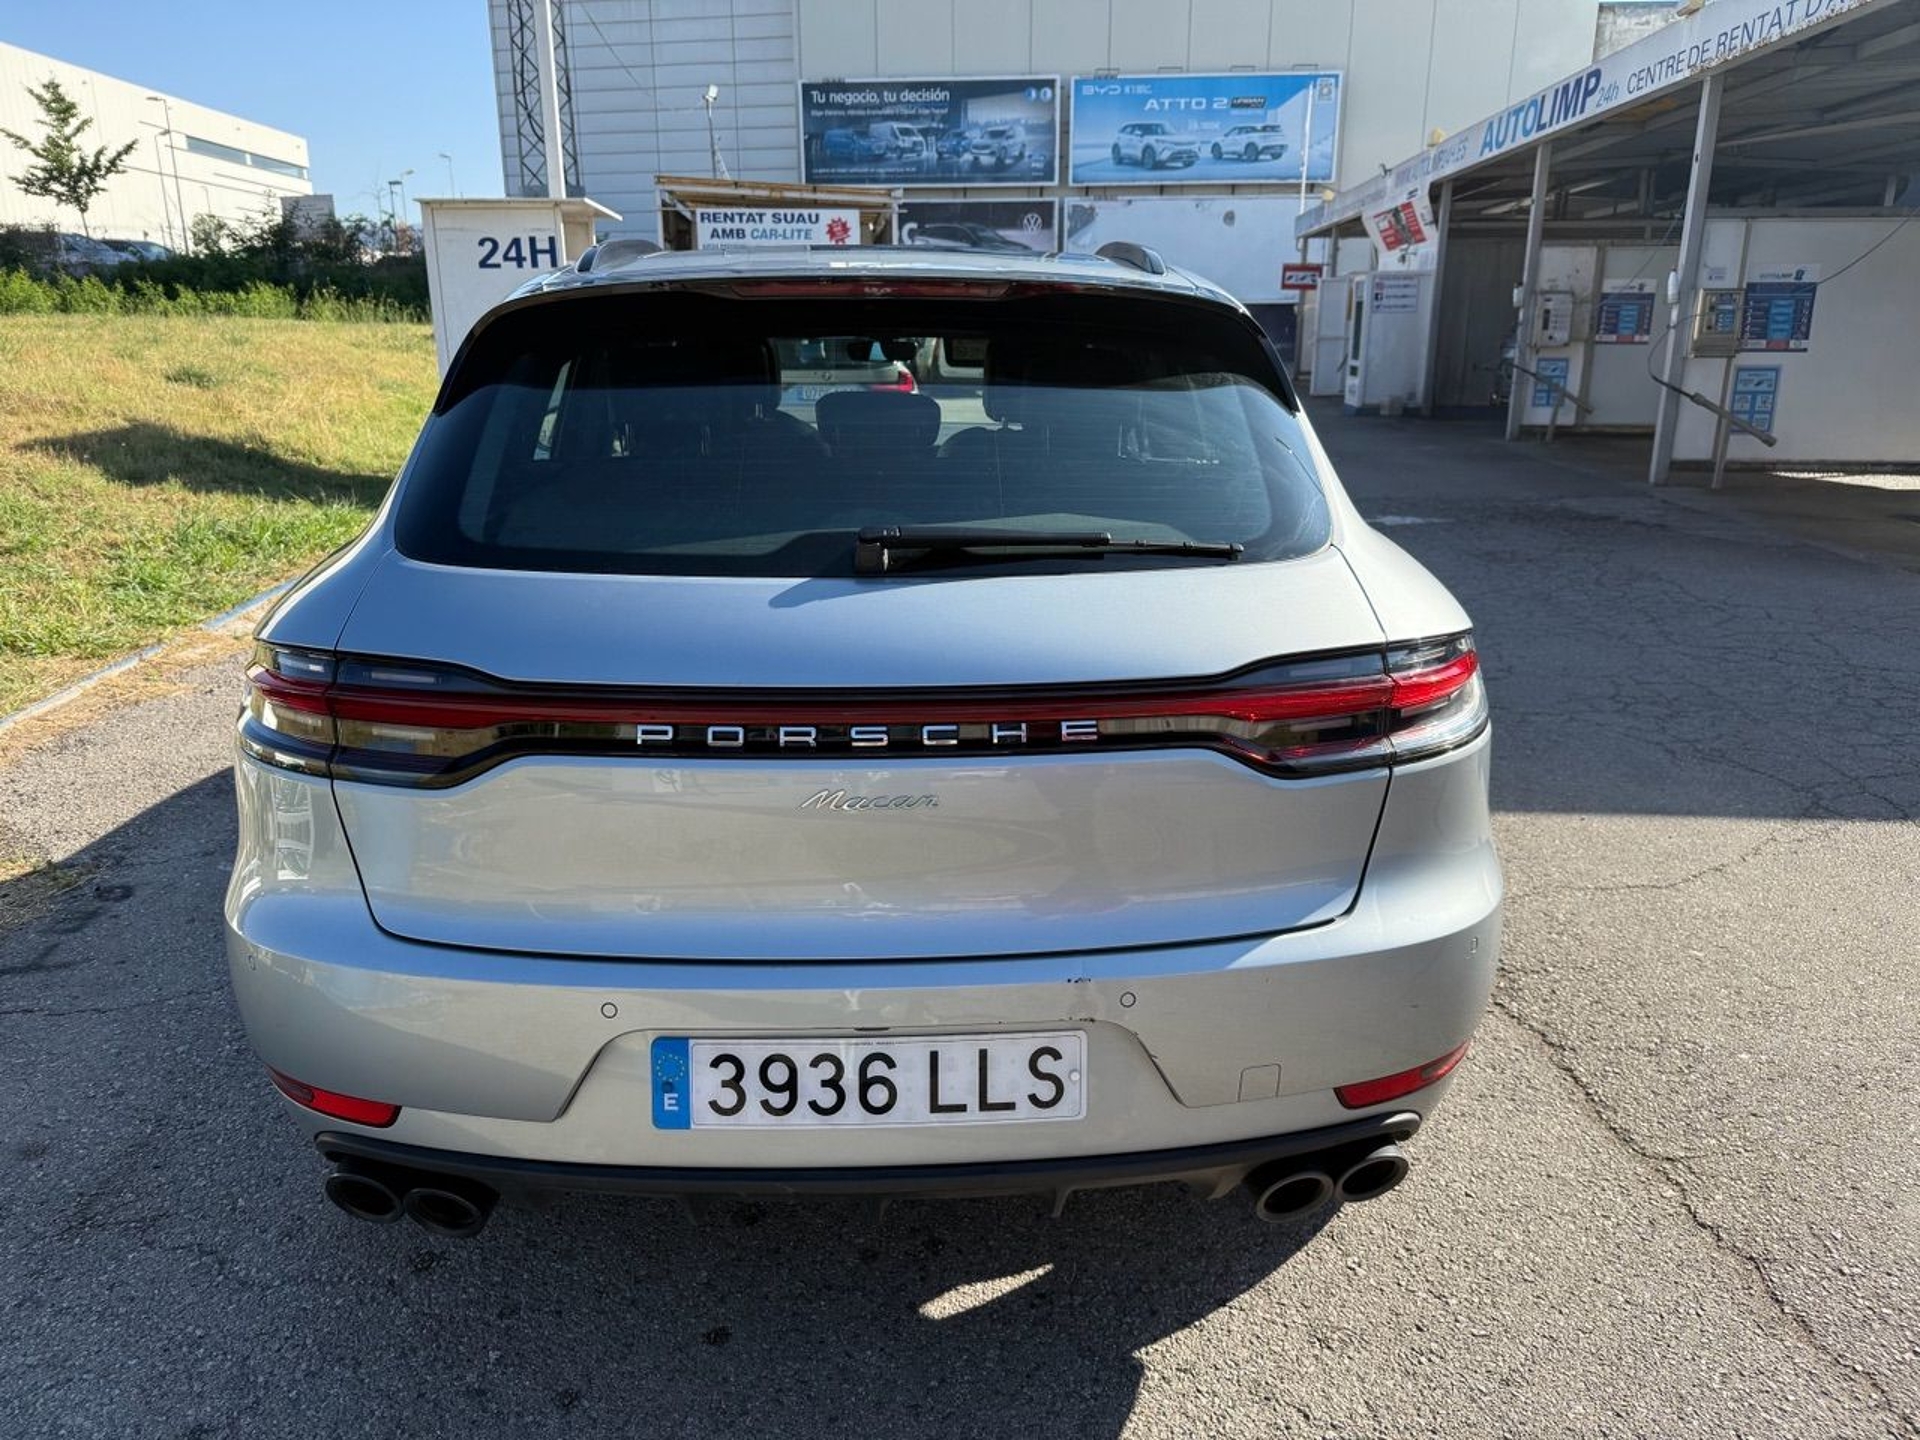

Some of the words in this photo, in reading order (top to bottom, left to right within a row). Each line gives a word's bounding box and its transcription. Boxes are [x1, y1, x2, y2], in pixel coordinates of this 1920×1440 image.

[1479, 68, 1602, 156] AUTOLIMP
[1626, 53, 1686, 94] CENTRE
[1687, 39, 1712, 68] DE
[1715, 0, 1800, 58] RENTAT
[810, 90, 825, 104] Tu
[829, 89, 880, 105] negocio,
[883, 90, 897, 102] tu
[900, 87, 950, 102] decisión
[1082, 84, 1121, 96] BYD
[1144, 97, 1207, 111] ATTO
[1212, 97, 1228, 110] 2
[700, 212, 767, 224] RENTAT
[771, 212, 820, 225] SUAU
[710, 227, 746, 240] AMB
[750, 227, 813, 241] CAR-LITE
[477, 235, 559, 269] 24H
[636, 720, 1099, 747] PORSCHE
[799, 789, 939, 811] Macan
[707, 1052, 898, 1117] 3936
[928, 1046, 1065, 1114] LLS
[663, 1093, 679, 1111] E
